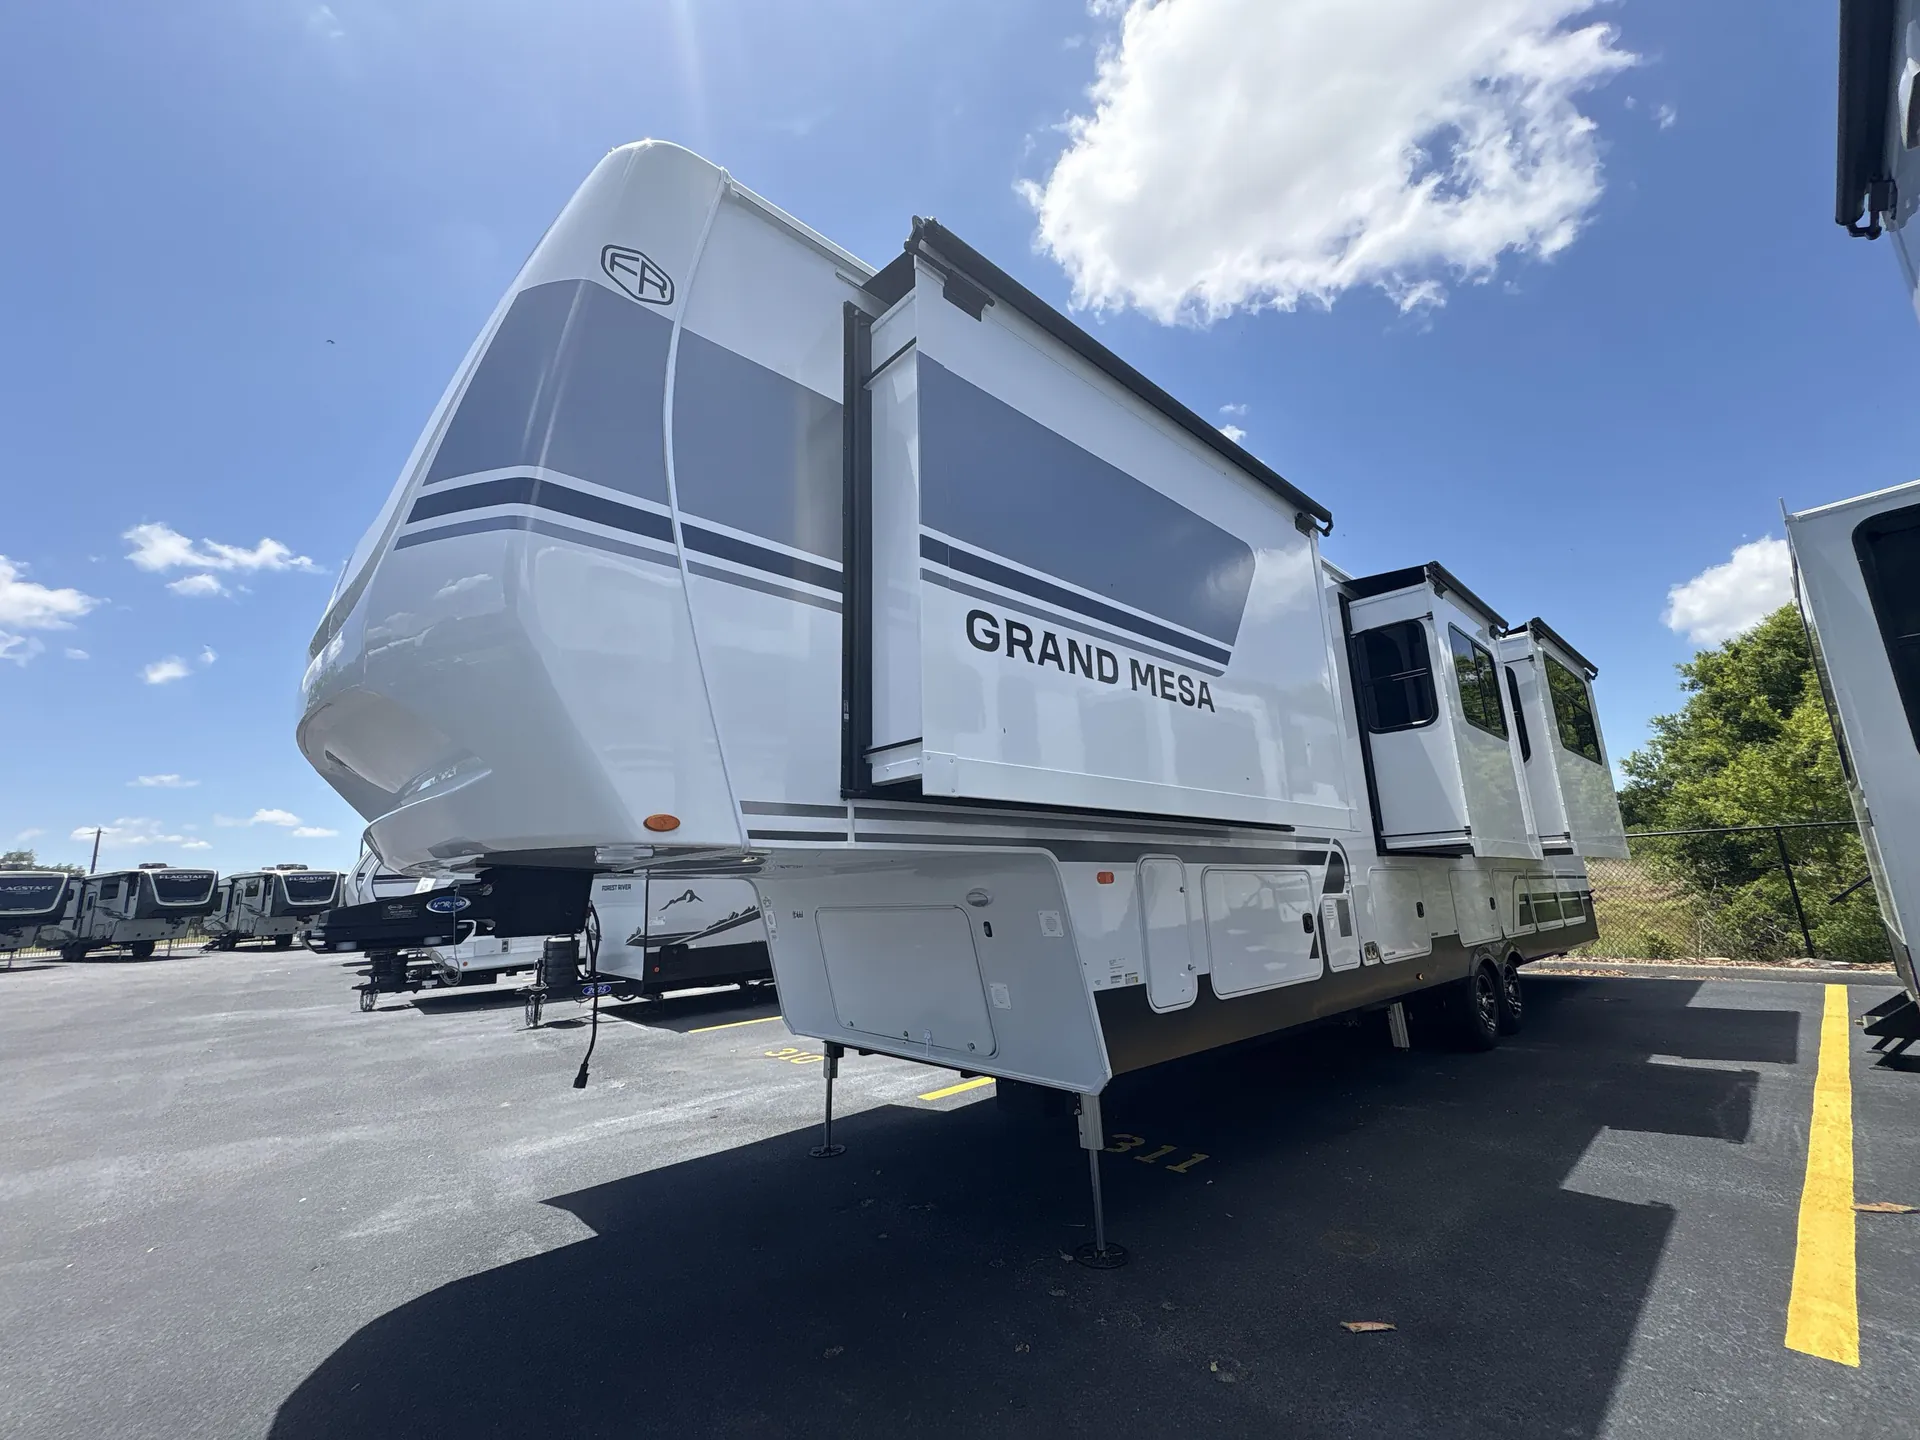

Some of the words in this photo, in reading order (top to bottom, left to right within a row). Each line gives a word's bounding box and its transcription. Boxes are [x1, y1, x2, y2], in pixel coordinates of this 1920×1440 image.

[966, 609, 1119, 685] GRAND
[1129, 657, 1216, 713] MESA
[618, 883, 631, 891] RIVER
[764, 1047, 825, 1064] 310
[1104, 1133, 1211, 1173] 311
